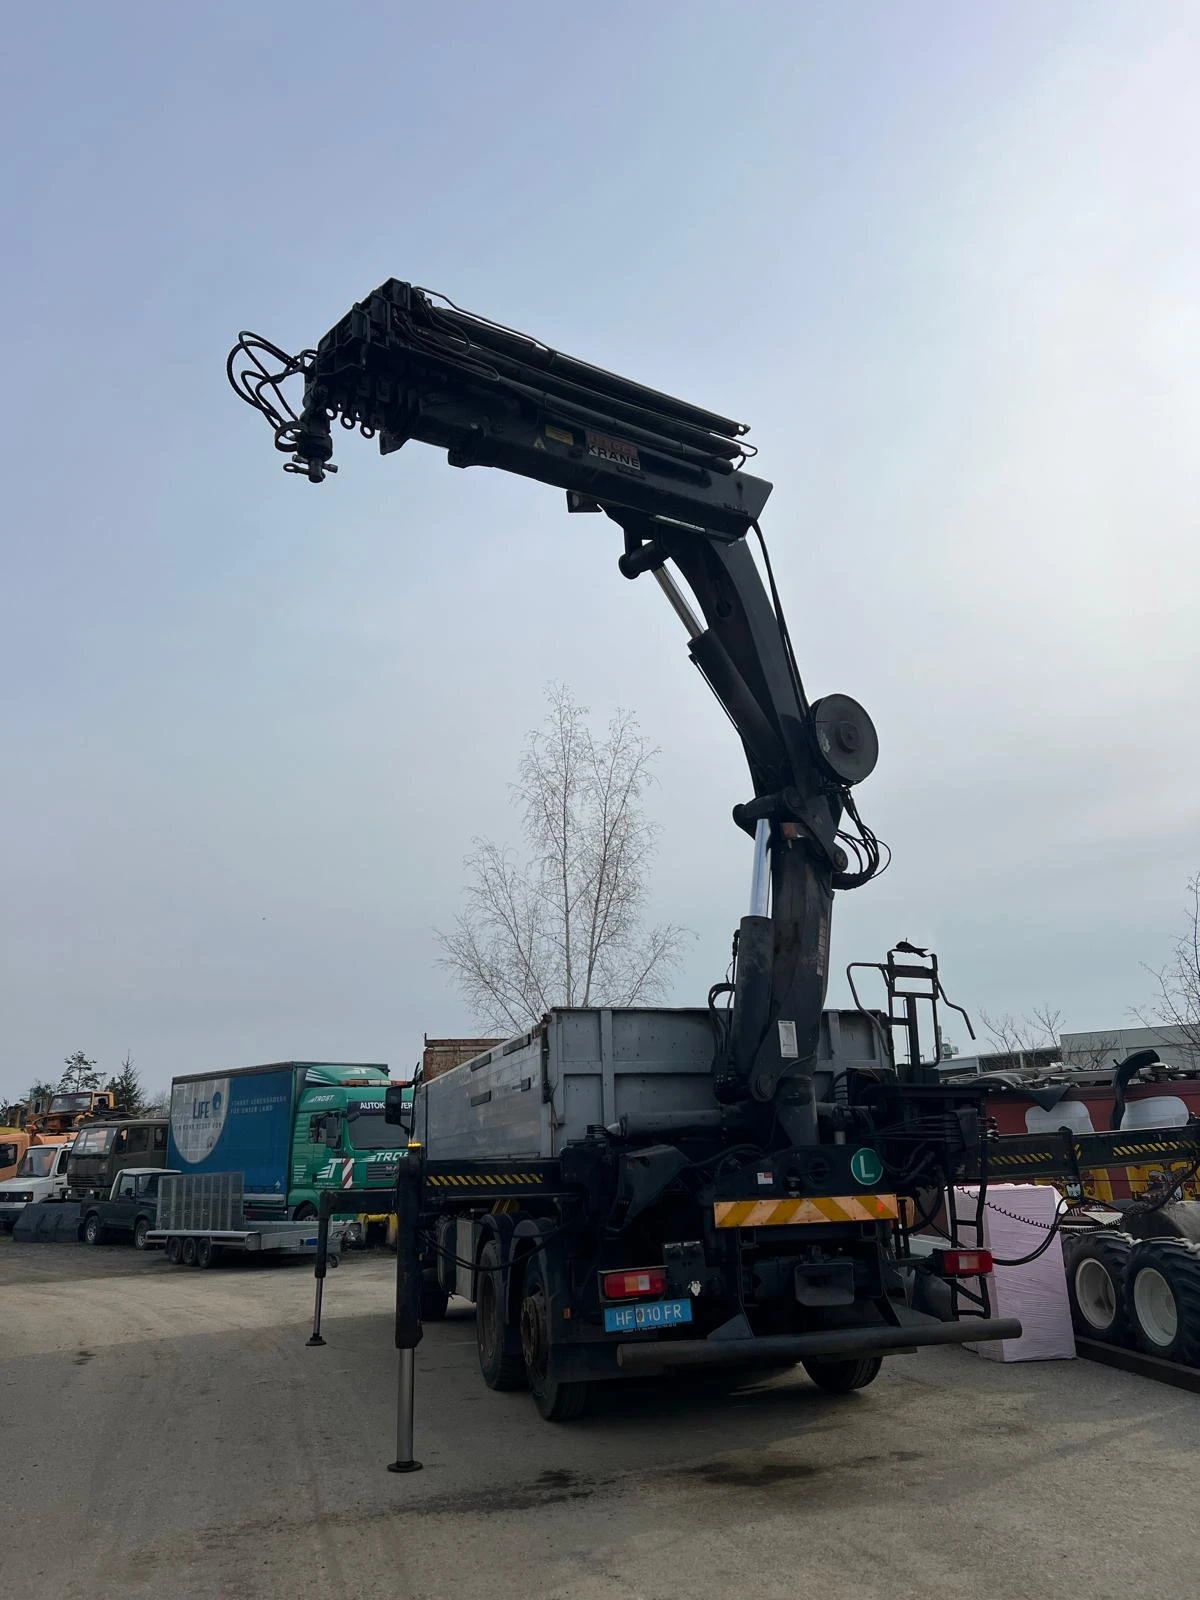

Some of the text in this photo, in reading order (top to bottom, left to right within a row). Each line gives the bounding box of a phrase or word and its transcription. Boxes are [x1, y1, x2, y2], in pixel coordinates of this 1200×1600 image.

[586, 444, 640, 469] KRANE
[314, 1094, 335, 1103] TROST
[860, 1155, 875, 1178] L
[616, 1304, 682, 1327] HF 10 FR
